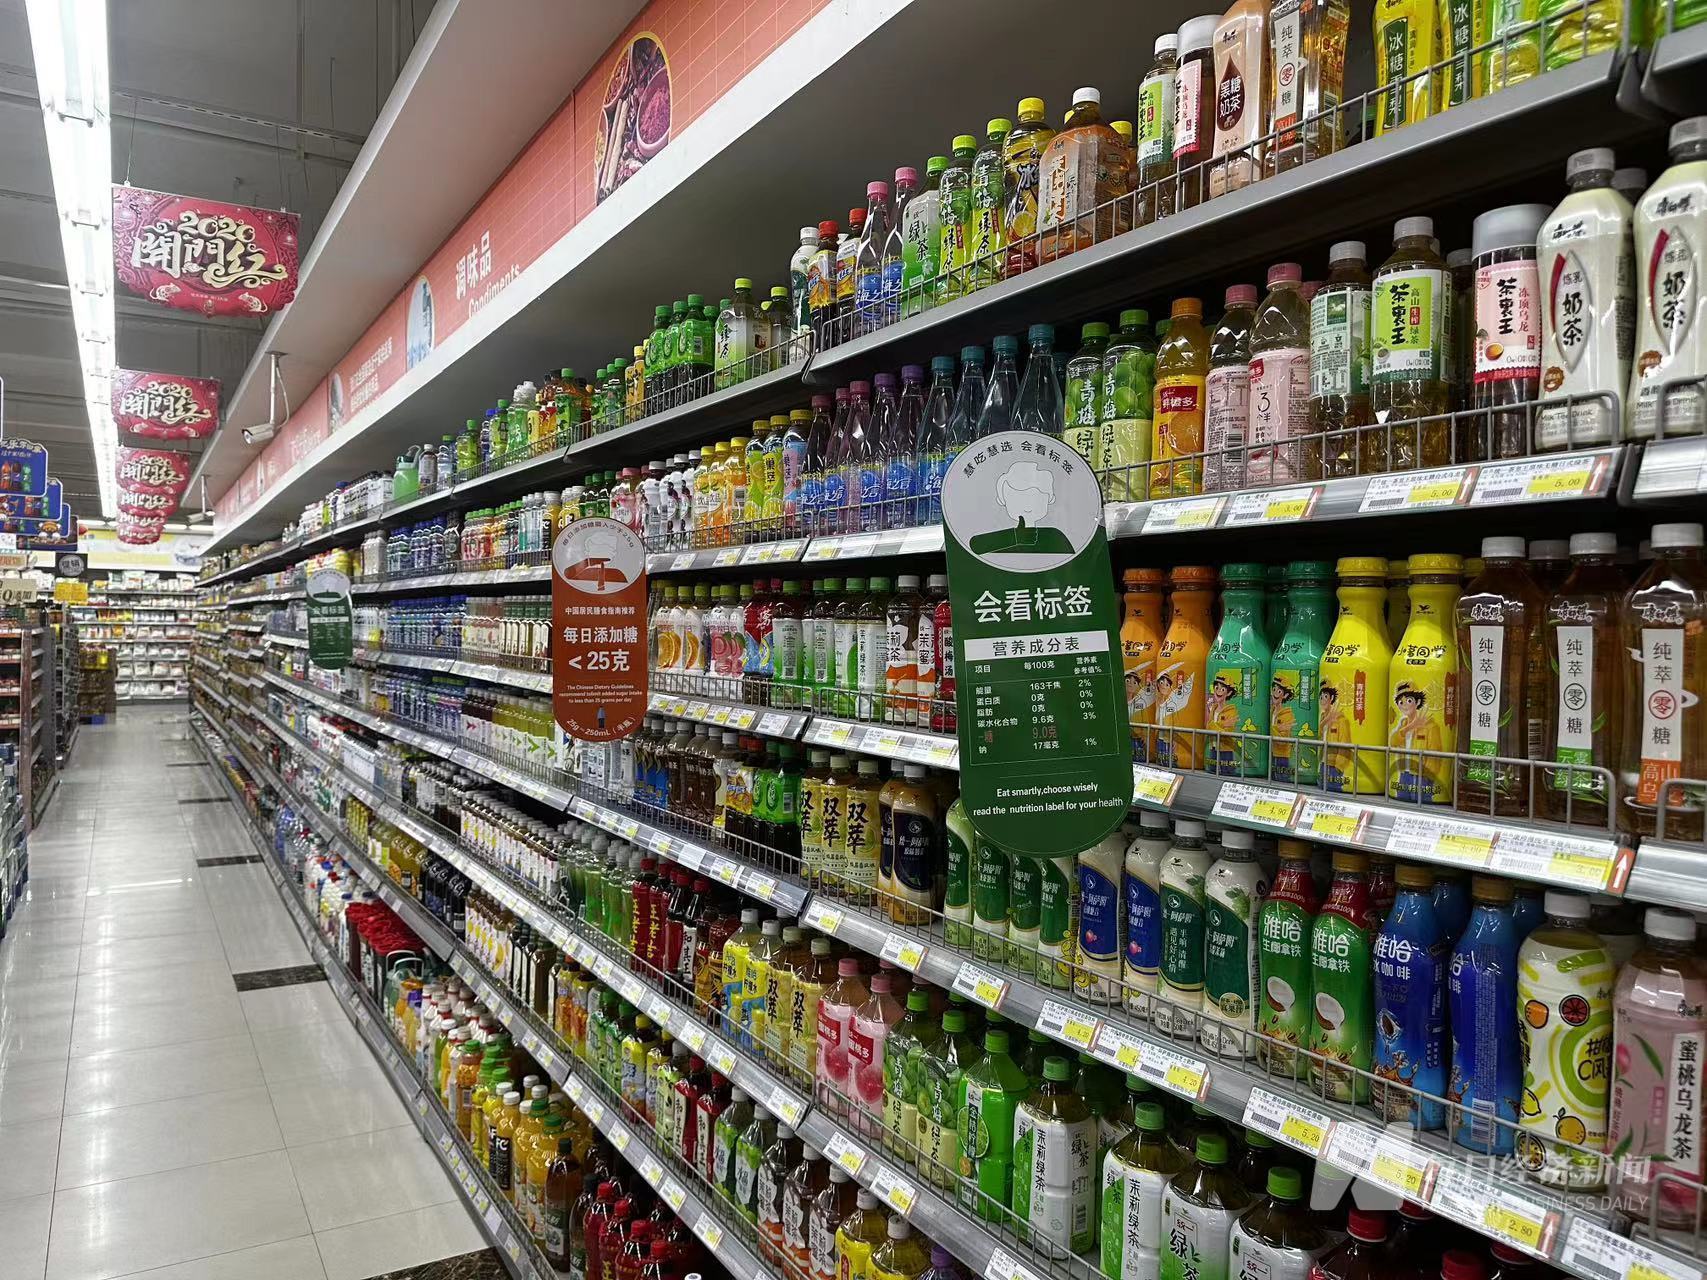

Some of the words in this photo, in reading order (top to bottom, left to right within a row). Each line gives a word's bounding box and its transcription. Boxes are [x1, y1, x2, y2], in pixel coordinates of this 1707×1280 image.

[177, 209, 256, 243] 2020
[456, 230, 492, 301] 调味品
[469, 264, 520, 320] Condiments
[1562, 292, 1583, 347] 奶茶
[147, 381, 193, 398] 2020
[1102, 370, 1117, 420] 青梅
[1077, 380, 1096, 425] 青梅
[963, 440, 1013, 478] 慧吃慧选
[1020, 440, 1073, 475] 会看标签
[565, 606, 635, 615] 中国居民膳食指南推荐
[973, 585, 1093, 623] 会看标签
[563, 626, 638, 644] 每日添加糖
[944, 636, 954, 677] 酸梅汤
[992, 636, 1080, 657] 营养成分表
[568, 655, 582, 670] <
[587, 648, 630, 672] 25克
[975, 665, 991, 674] 项目
[1024, 660, 1056, 671] 每100克
[1076, 656, 1098, 665] 营养素
[975, 686, 992, 696] 能量
[1030, 681, 1061, 691] 163千焦
[1078, 678, 1092, 688] 2%
[1478, 637, 1495, 728] 纯萃零糖
[1566, 638, 1584, 734] 纯萃零糖
[976, 696, 1001, 706] 蛋白质
[1031, 693, 1045, 702] 0克
[1080, 689, 1093, 698] 0%
[1651, 642, 1673, 745] 纯萃零糖
[976, 707, 993, 717] 脂肪
[1031, 704, 1046, 713] 0克
[1080, 700, 1093, 709] 0%
[977, 717, 1018, 728] 碳水化合物
[1032, 715, 1055, 724] 9.6克
[1083, 711, 1097, 720] 3%
[1033, 725, 1057, 740] 9.0克
[978, 745, 987, 754] 钠
[1033, 741, 1060, 750] 17毫克
[1084, 737, 1097, 746] 1%
[996, 788, 1010, 798] Eat
[1073, 782, 1098, 794] wisely
[973, 806, 991, 816] read
[992, 805, 1006, 815] the
[1010, 803, 1044, 814] nutrition
[1045, 802, 1064, 812] label
[1066, 801, 1077, 810] for
[1079, 801, 1097, 812] your
[1098, 797, 1123, 808] health
[1270, 806, 1286, 815] 4.90
[847, 802, 869, 855] 双萃
[1264, 913, 1302, 942] 雅哈
[1262, 938, 1302, 958] 生椰拿铁
[1312, 927, 1351, 957] 雅哈
[1373, 932, 1413, 963] 雅哈
[1311, 952, 1351, 973] 生椰拿铁
[1672, 1039, 1699, 1160] 蜜桃乌龙茶
[1302, 1128, 1320, 1142] 5.20
[1034, 1128, 1047, 1193] 茉莉绿茶
[1395, 1169, 1416, 1185] 5.20
[1128, 1178, 1141, 1249] 茉莉绿茶
[1176, 1218, 1195, 1230] 统一
[1508, 1219, 1533, 1237] 2.80
[1246, 1260, 1268, 1272] 统一
